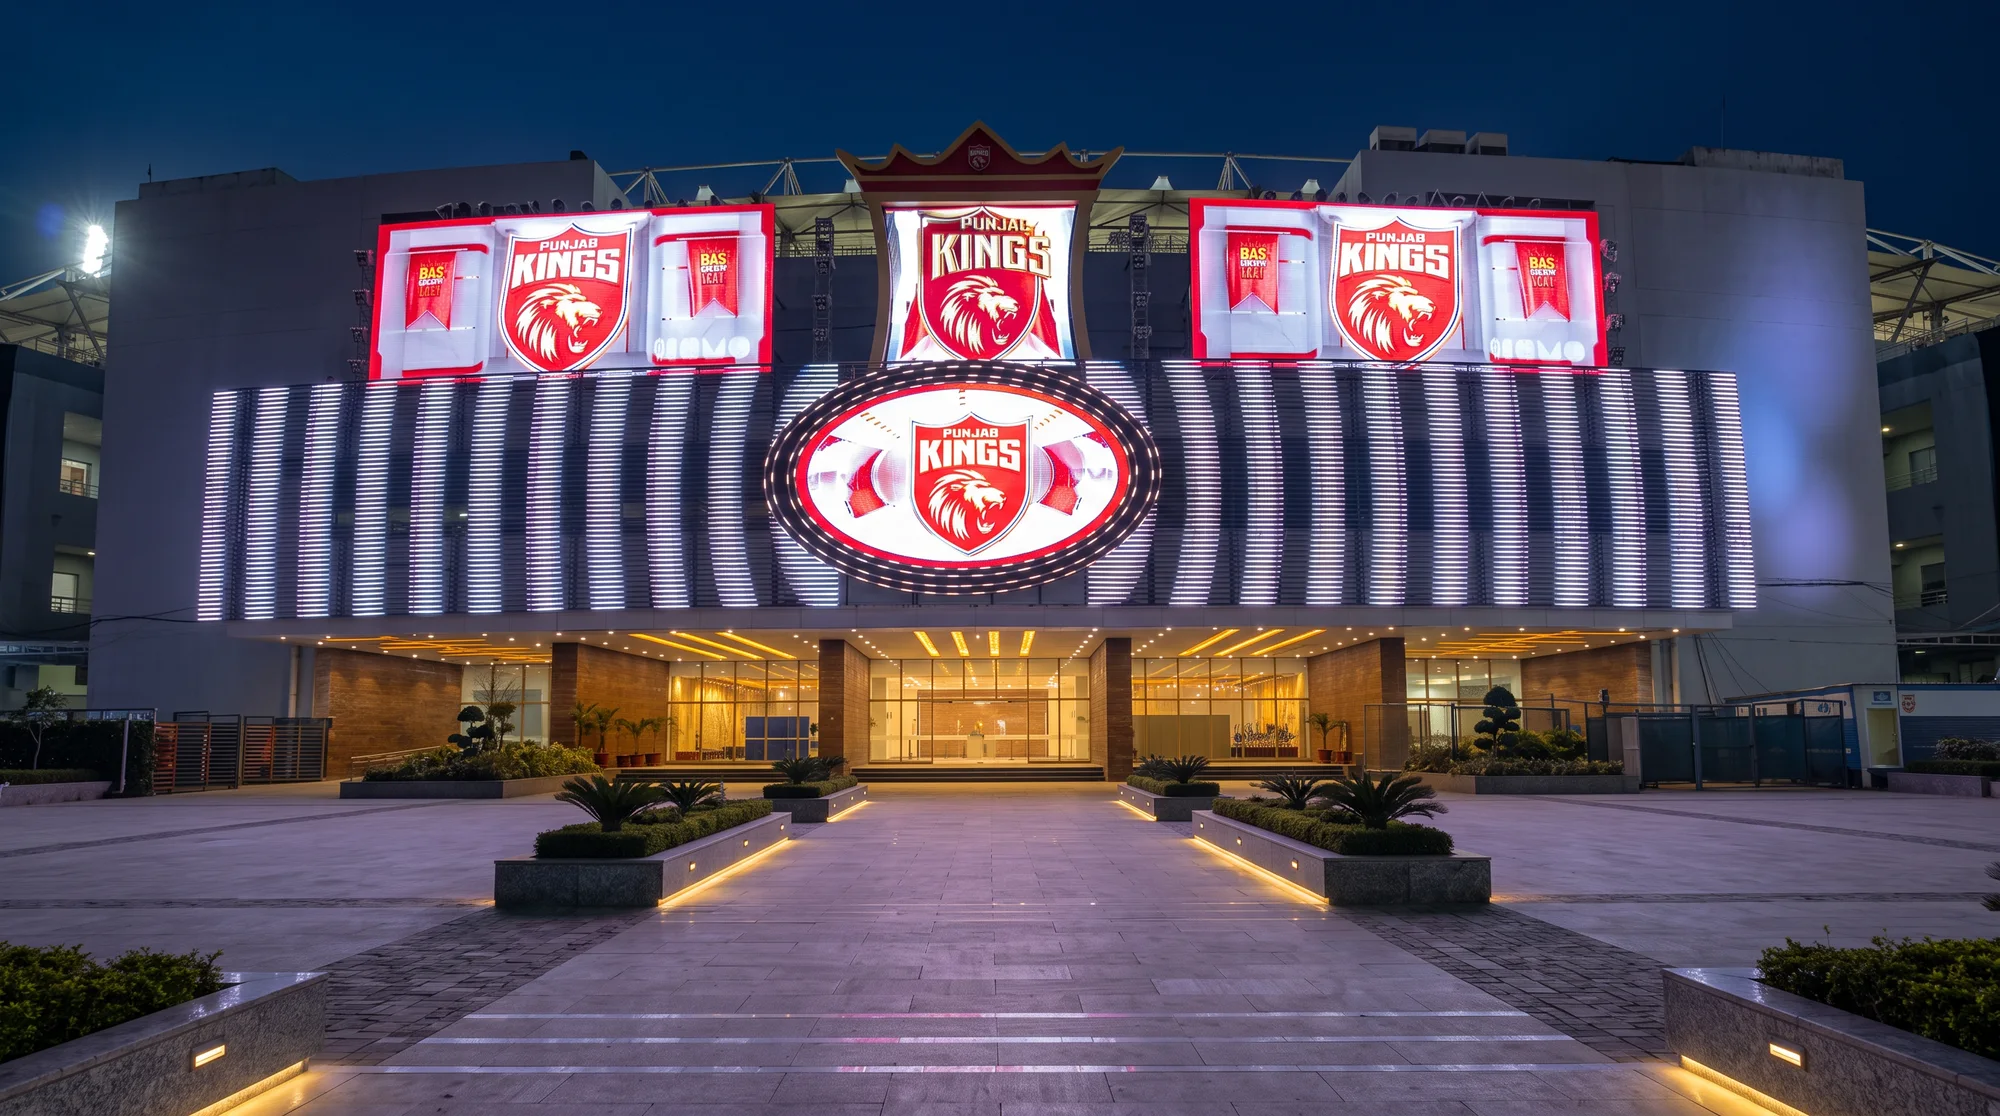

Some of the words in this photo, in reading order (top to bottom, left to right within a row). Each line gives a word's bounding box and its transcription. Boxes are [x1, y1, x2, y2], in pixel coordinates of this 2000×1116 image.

[1366, 232, 1426, 243] PUNJAB
[539, 238, 598, 251] PUNJAB
[700, 252, 727, 266] BAS
[931, 233, 1052, 281] KINGS
[1240, 247, 1267, 260] BAS
[1340, 242, 1450, 280] KINGS
[1529, 256, 1555, 269] BAS
[419, 266, 445, 279] BAS
[511, 248, 621, 290] KINGS
[943, 428, 999, 438] PUNJAB
[919, 439, 1021, 474] KINGS
